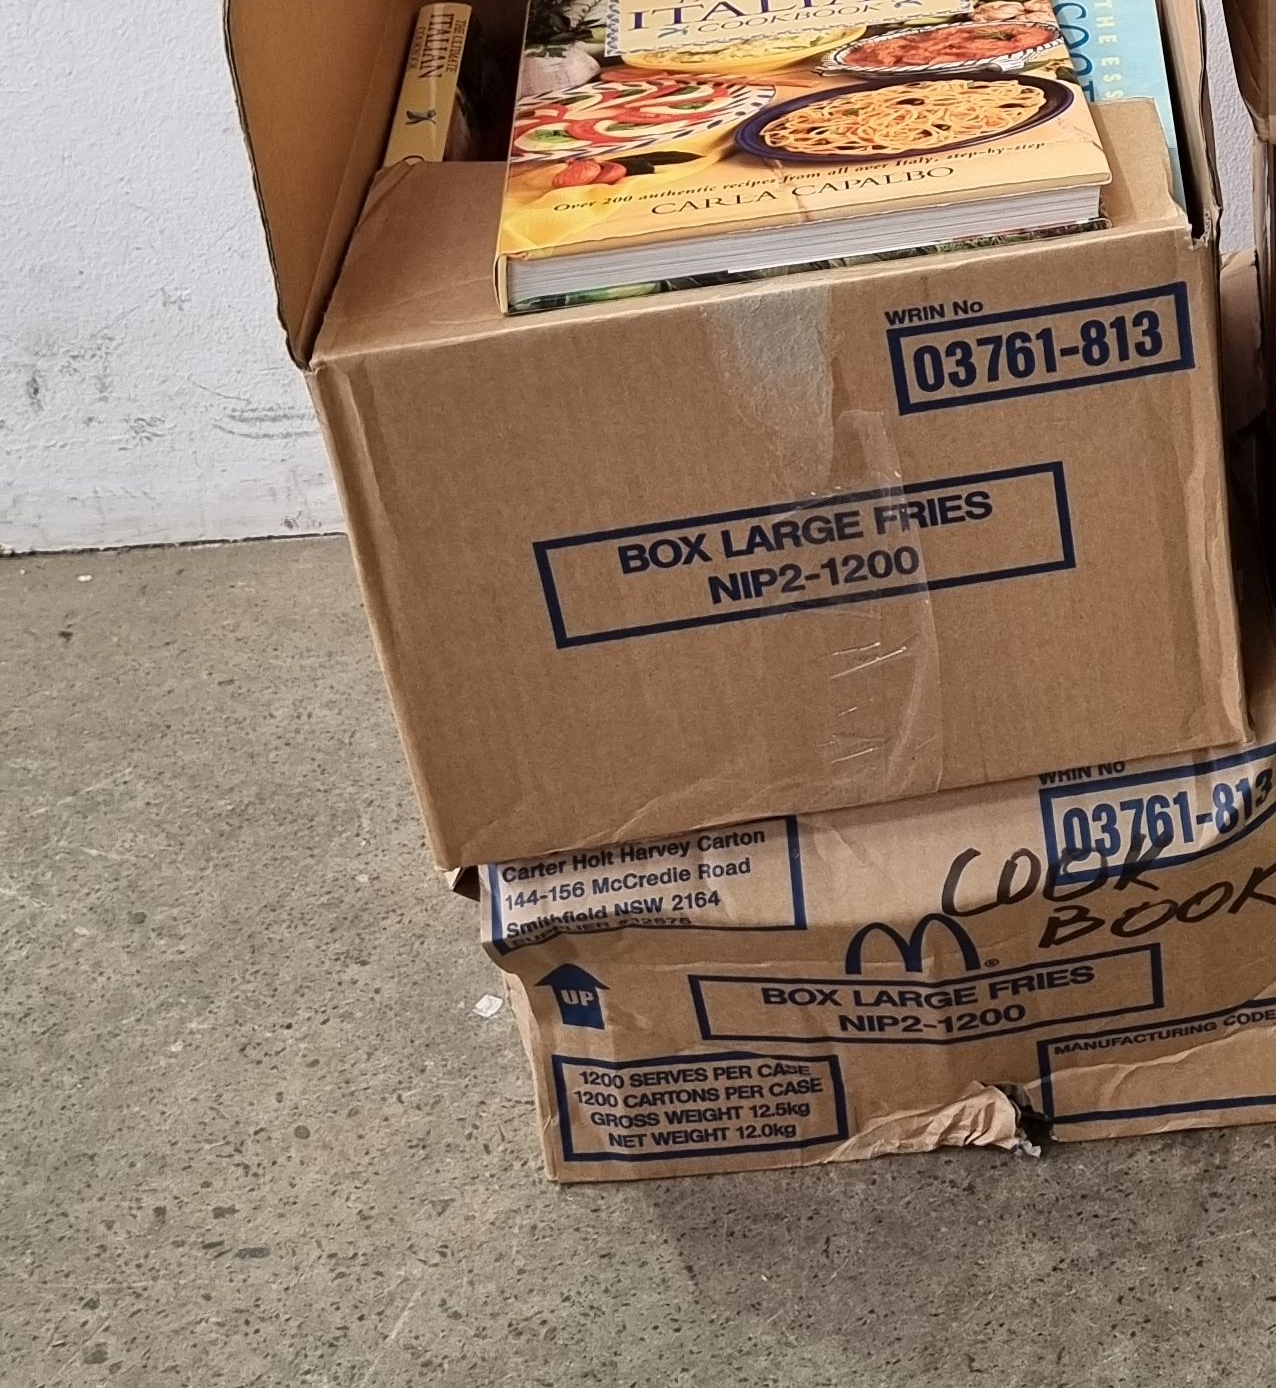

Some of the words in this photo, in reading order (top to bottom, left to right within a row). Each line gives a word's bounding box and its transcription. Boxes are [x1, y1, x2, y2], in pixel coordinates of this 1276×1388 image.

[697, 2, 884, 33] COOKBOOK
[1095, 0, 1117, 44] THE
[418, 13, 455, 78] ITALIAN
[554, 200, 596, 211] Over
[603, 196, 633, 205] 200
[639, 186, 716, 201] authentic
[722, 178, 776, 190] recipes
[778, 173, 820, 184] from
[827, 167, 848, 176] all
[855, 163, 887, 172] over
[945, 142, 1046, 160] step-by-step
[651, 190, 779, 215] CARLA
[791, 166, 954, 197] CAPALBO
[885, 304, 945, 325] WRIN
[953, 300, 984, 316] No
[913, 311, 1163, 392] 03761-813
[617, 533, 712, 574] BOX
[721, 510, 863, 560] LARGE
[874, 491, 993, 536] FRIES
[708, 546, 920, 605] NIP2-1200
[1062, 768, 1274, 862] 03761-813
[502, 860, 567, 884] Carter
[572, 851, 614, 871] Holt
[621, 841, 691, 864] Harvey
[697, 829, 765, 852] Carton
[505, 882, 585, 911] 144-156
[592, 867, 691, 895] McCredie
[698, 858, 751, 879] Road
[506, 905, 608, 940] Smithfield
[614, 897, 664, 916] NSW
[671, 890, 721, 912] 2164
[562, 989, 594, 1006] UP
[761, 987, 843, 1006] BOX
[853, 985, 978, 1009] LARGE
[989, 965, 1096, 998] FRIES
[839, 1003, 1026, 1033] NIP2-1200
